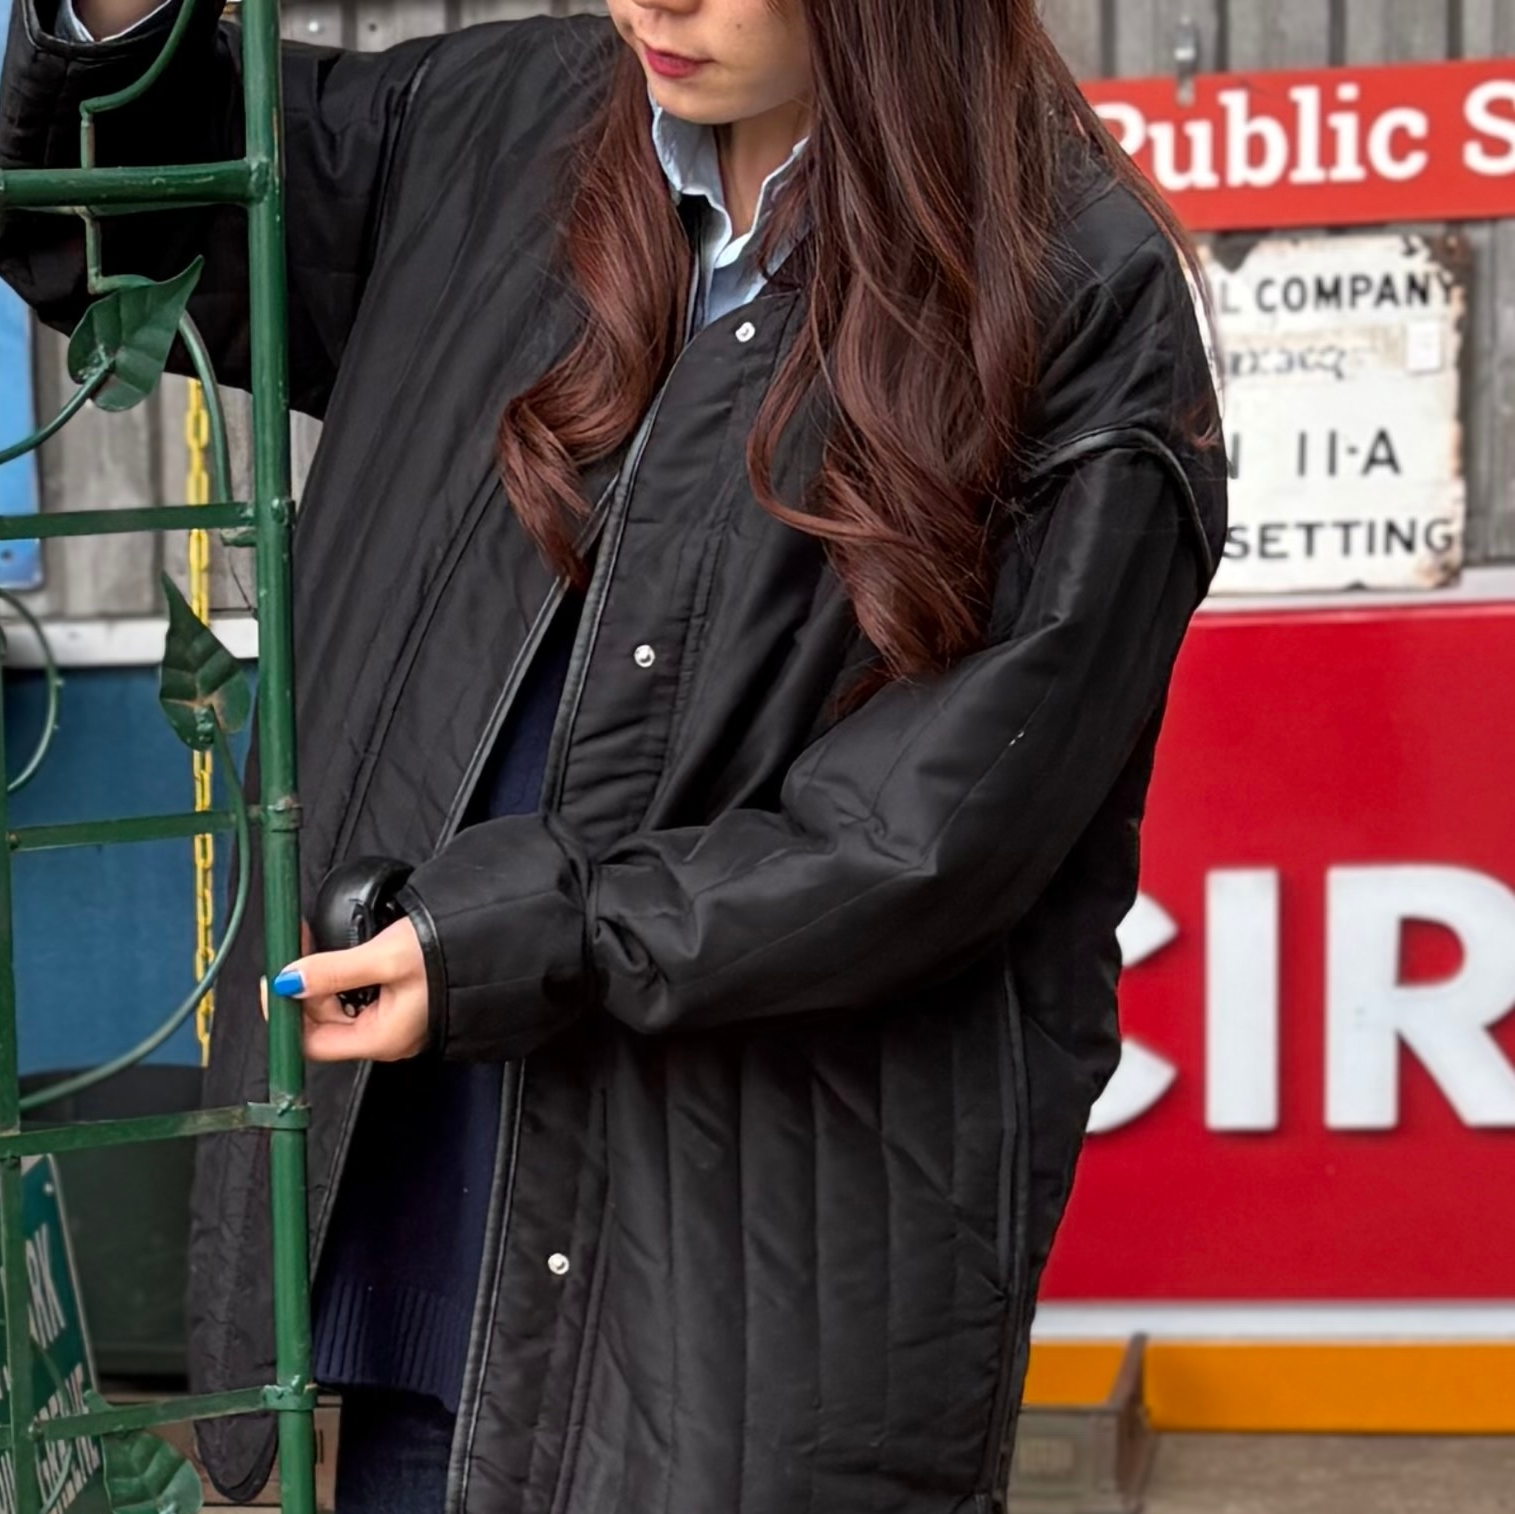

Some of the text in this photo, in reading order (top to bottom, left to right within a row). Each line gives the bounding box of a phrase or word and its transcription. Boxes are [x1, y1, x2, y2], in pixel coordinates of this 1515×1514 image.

[1094, 84, 1428, 189] Public
[1223, 518, 1454, 559] SETTING
[1084, 865, 1515, 1133] IR
[1, 1223, 66, 1351] RK
